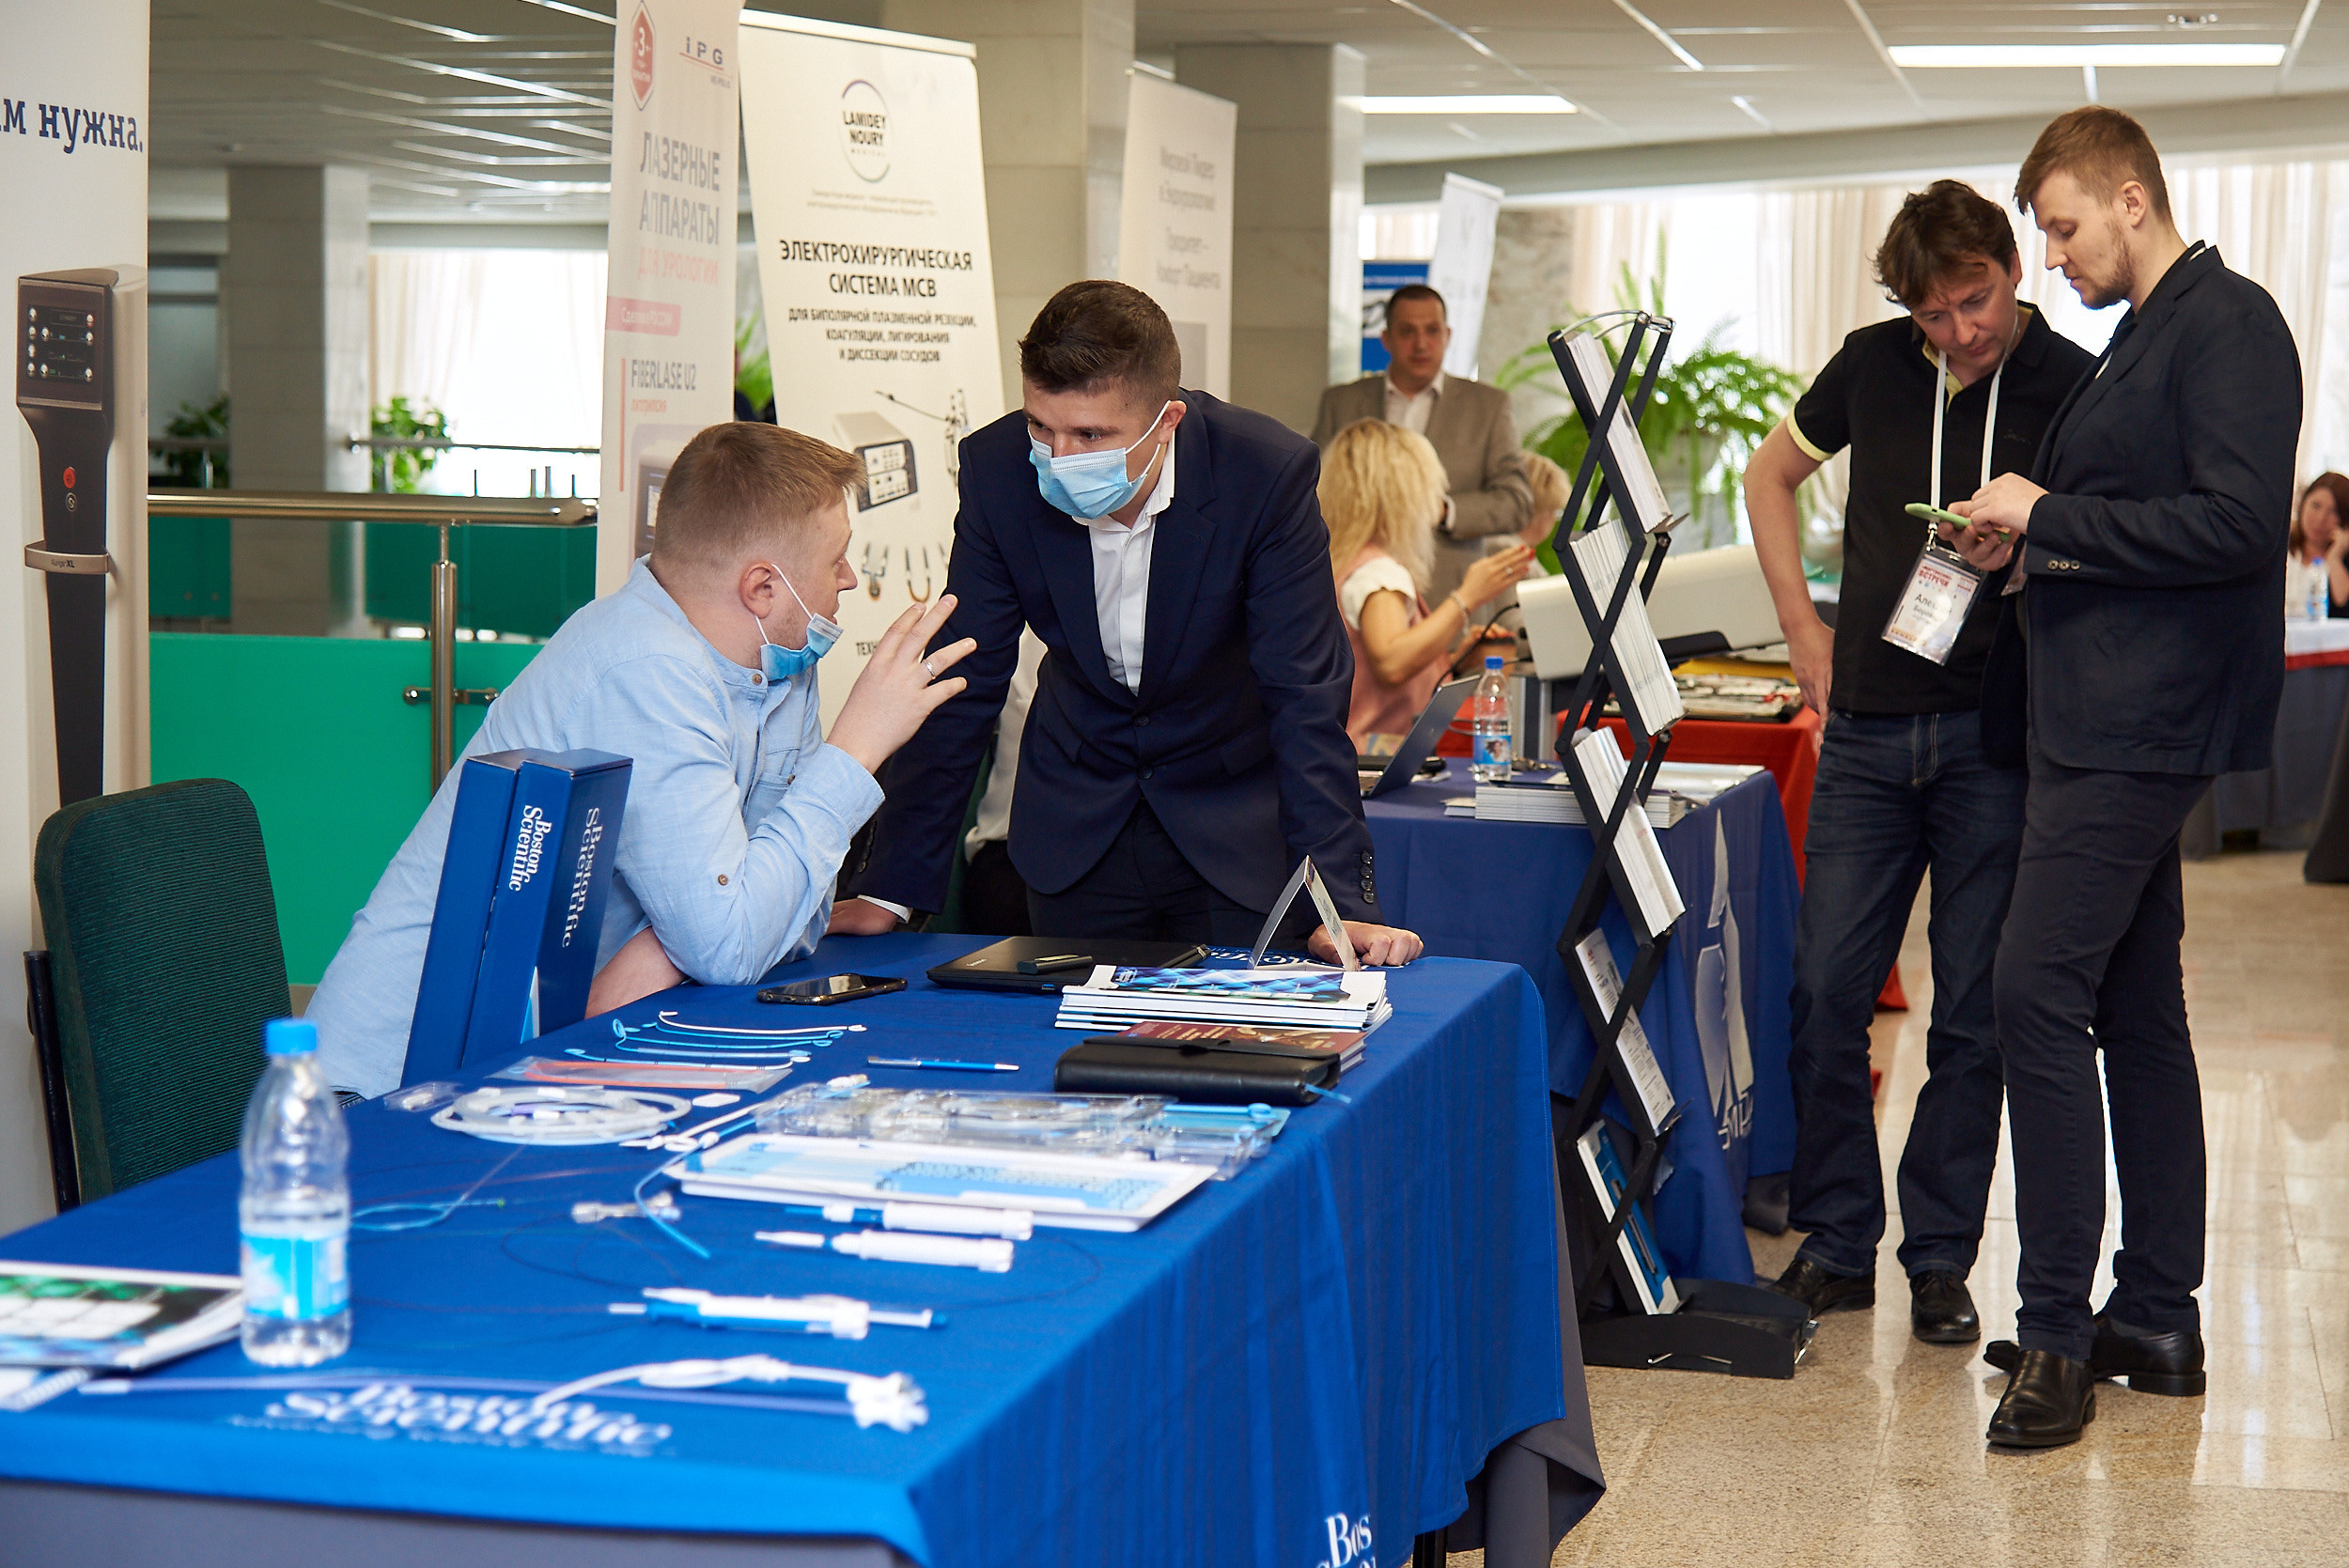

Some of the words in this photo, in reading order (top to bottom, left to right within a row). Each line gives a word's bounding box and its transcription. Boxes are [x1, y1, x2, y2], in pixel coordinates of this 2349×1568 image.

[636, 26, 646, 56] 3
[0, 99, 26, 134] м
[39, 103, 143, 154] нужна.
[843, 111, 886, 129] LAMIDEY
[849, 130, 883, 146] NOURY
[640, 132, 720, 192] ЛАЗЕРНЫЕ
[639, 189, 719, 245] АППАРАТЫ
[780, 241, 972, 271] ЭЛЕКТРОХИРУРГИЧЕСКАЯ
[830, 273, 899, 297] СИСТЕМА
[788, 308, 808, 322] ДЛЯ
[811, 308, 870, 323] БИПОЛЯРНОЙ
[872, 310, 931, 325] ПЛАЗМЕННОЙ
[888, 330, 950, 344] ЛИГИРОВАНИЯ
[848, 348, 898, 362] ДИССЕКЦИИ
[900, 349, 941, 363] СОСУДОВ
[630, 359, 682, 391] FIBERLASE
[1919, 569, 1950, 588] ВСТРЕЧИ
[508, 804, 543, 892] Scientific
[526, 820, 553, 875] Boston
[562, 807, 600, 948] Scientific
[577, 825, 603, 912] Boston
[1324, 1512, 1372, 1568] Bos
